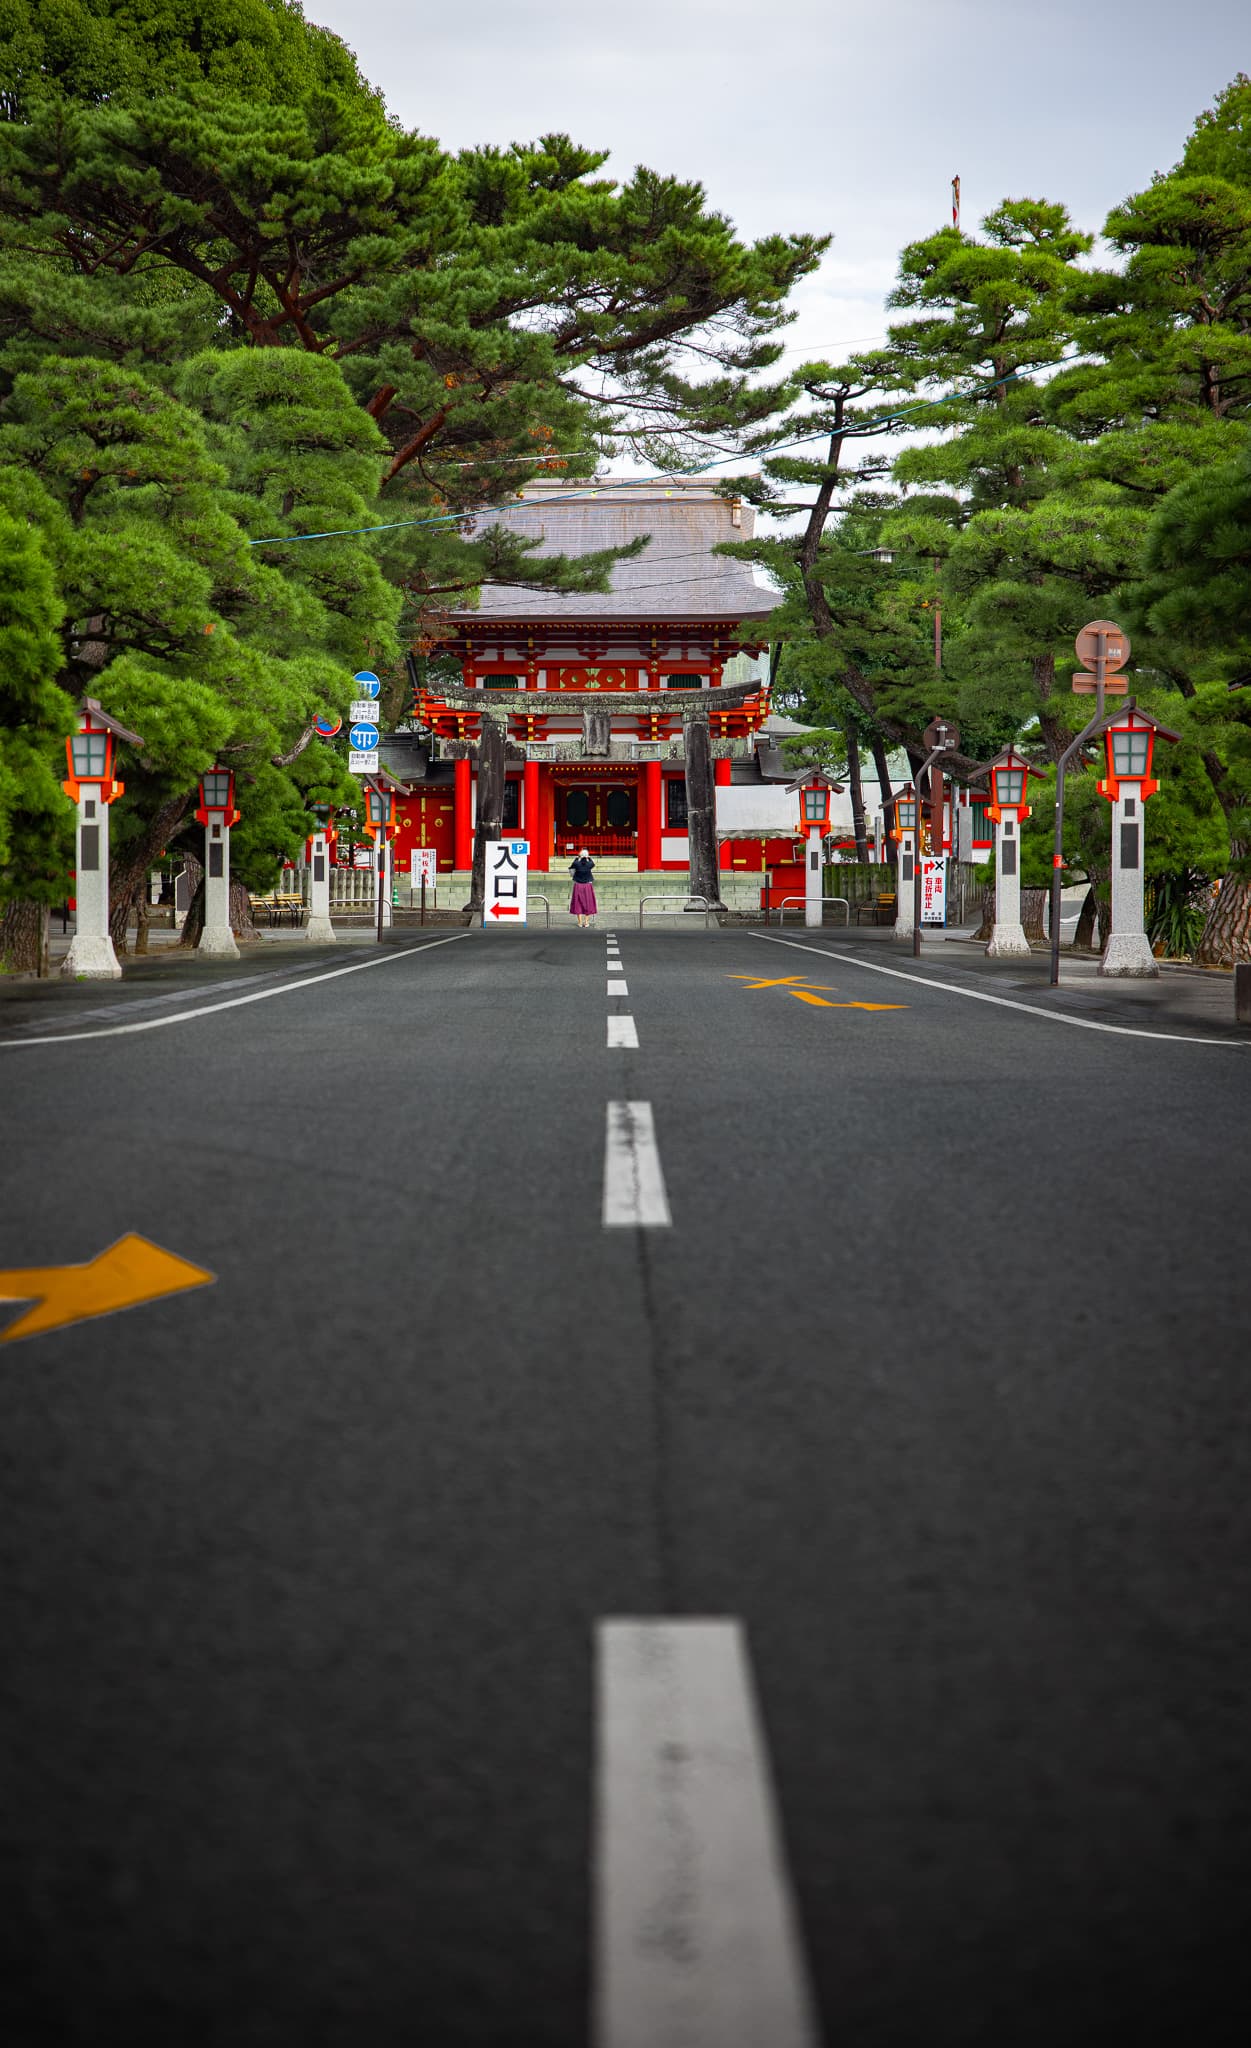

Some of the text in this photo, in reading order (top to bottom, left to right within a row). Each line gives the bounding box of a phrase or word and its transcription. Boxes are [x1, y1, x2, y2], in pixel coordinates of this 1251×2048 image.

[516, 844, 524, 853] P
[493, 846, 519, 898] 入口
[924, 877, 933, 909] 右折禁止
[935, 877, 943, 893] 車両
